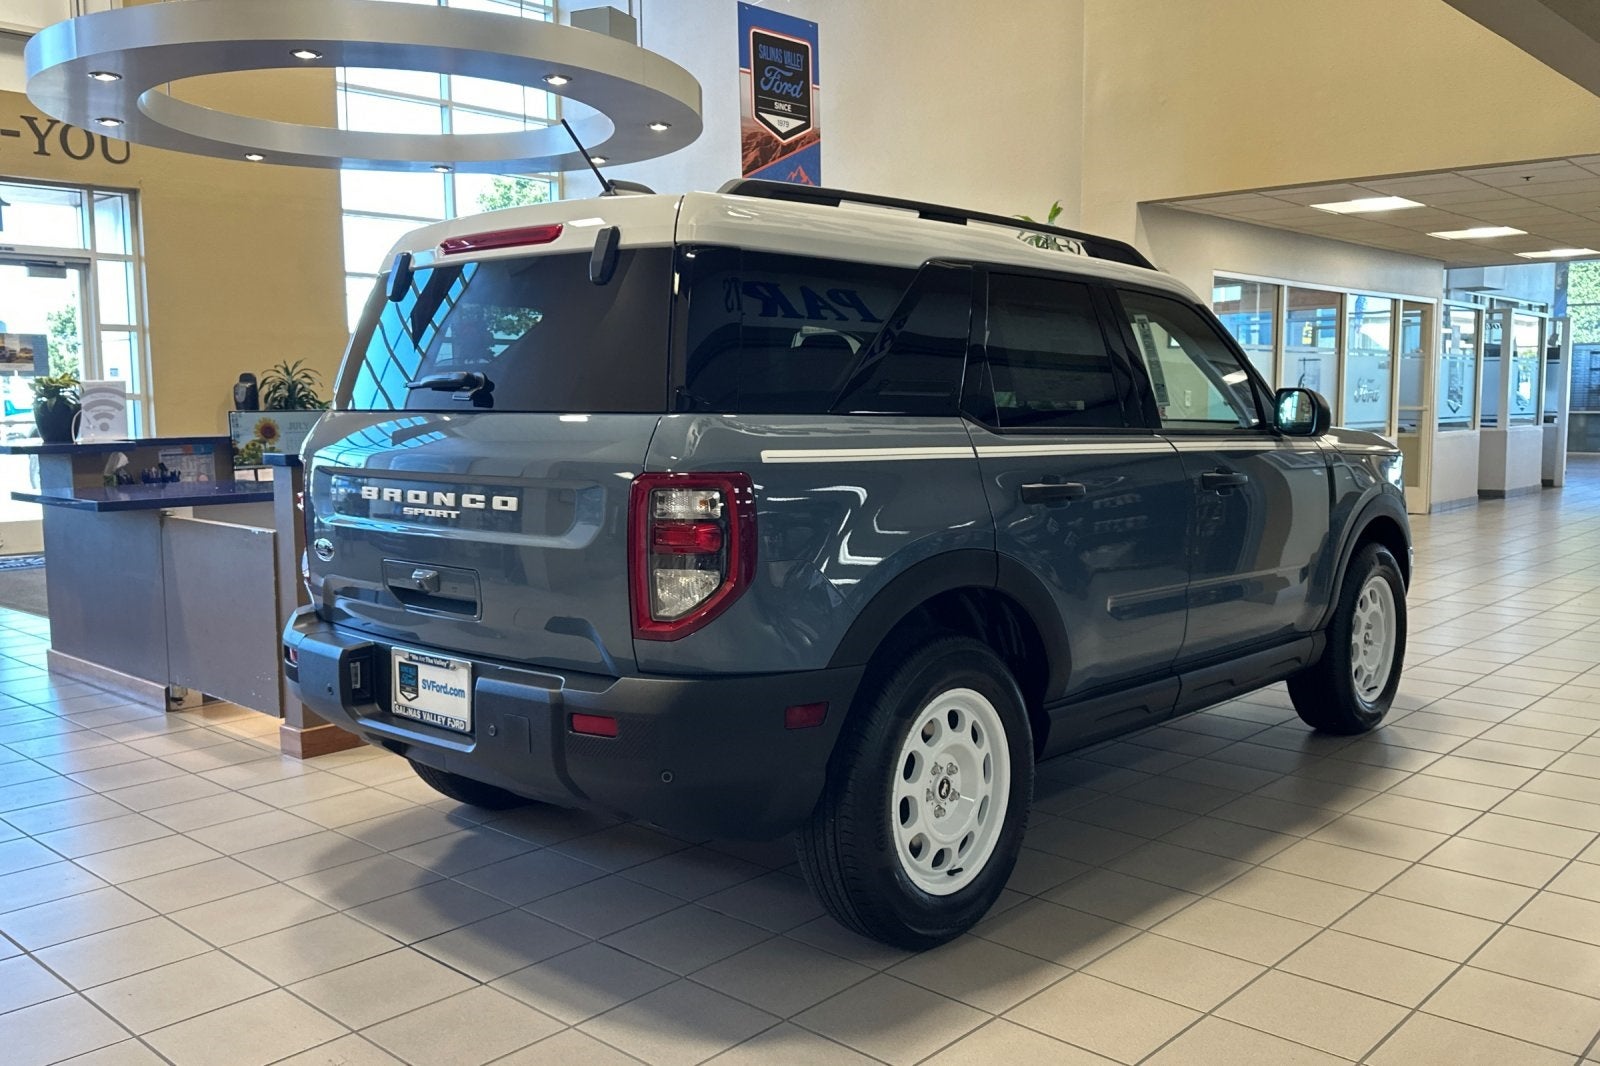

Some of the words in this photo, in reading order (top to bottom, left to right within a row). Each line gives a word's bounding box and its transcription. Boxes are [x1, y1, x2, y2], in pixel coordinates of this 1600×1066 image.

[758, 44, 783, 64] SALINAS
[784, 50, 804, 71] VALLEY
[760, 65, 804, 98] Ford
[774, 101, 792, 112] SINCE
[777, 119, 790, 128] 1979
[361, 486, 518, 511] BRONCO
[403, 507, 460, 519] SPORT
[421, 678, 466, 698] SVFord.com
[395, 704, 421, 718] SALINAS
[422, 711, 446, 725] VALLEY
[447, 718, 465, 730] FORD
